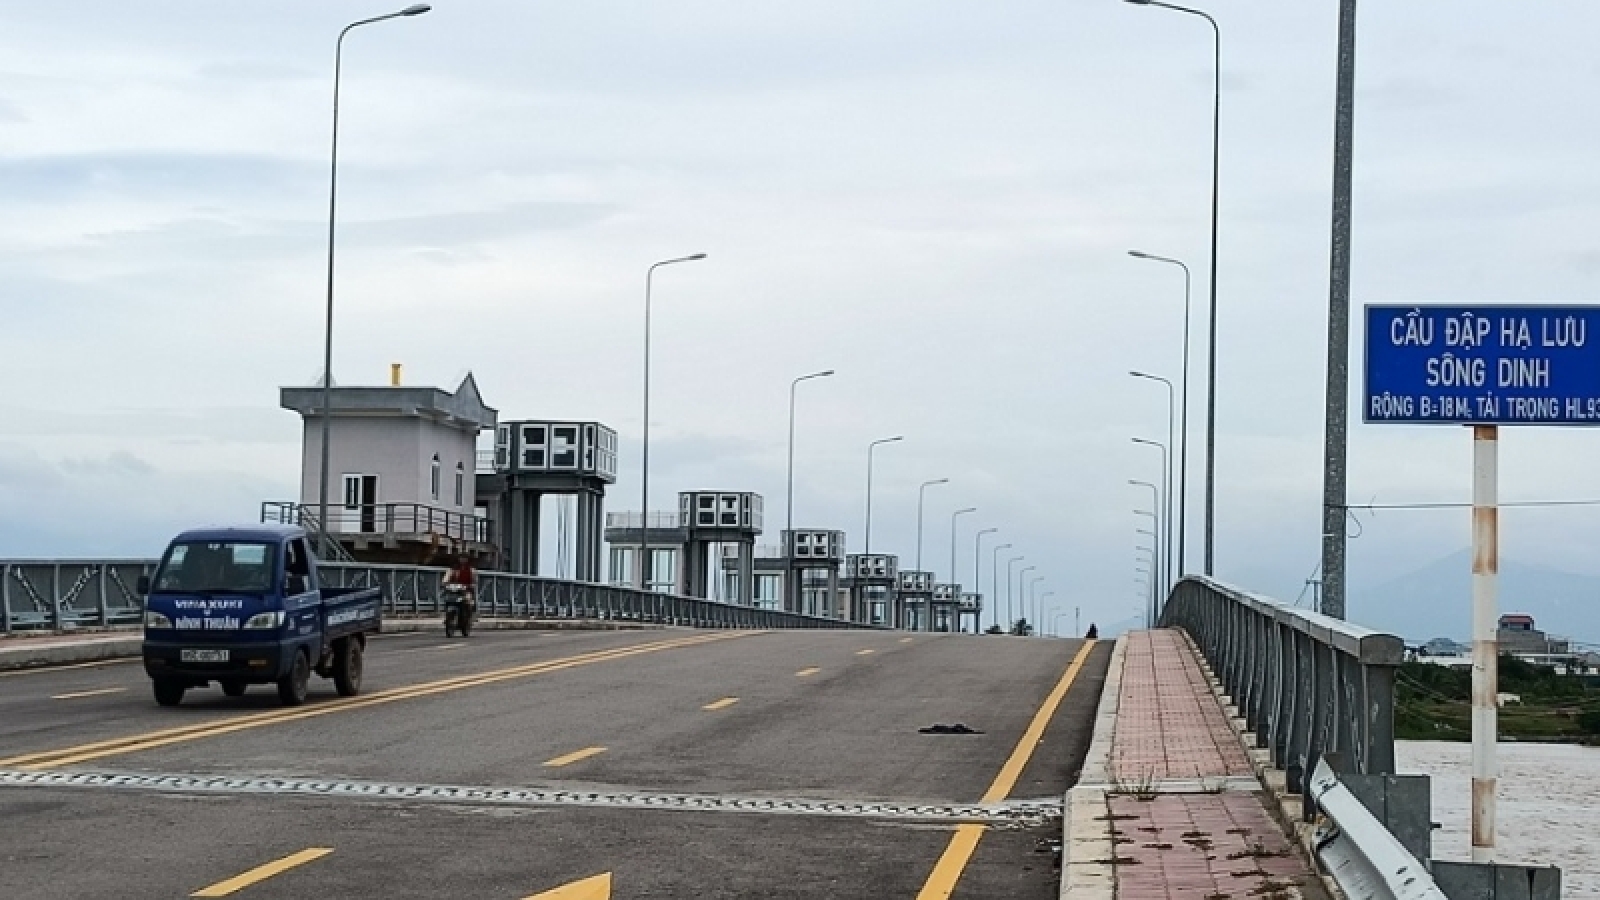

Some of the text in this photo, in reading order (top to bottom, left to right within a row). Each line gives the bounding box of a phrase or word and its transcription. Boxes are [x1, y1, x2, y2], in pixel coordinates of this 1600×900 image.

[1445, 311, 1491, 350] ĐẬP
[1499, 317, 1532, 350] HẠ
[1542, 315, 1586, 347] LƯU
[1426, 352, 1550, 388] SÔNG DINH
[1371, 391, 1414, 419] RỘNG
[1476, 390, 1499, 418] TẢI
[1506, 397, 1559, 420] TRỌNG
